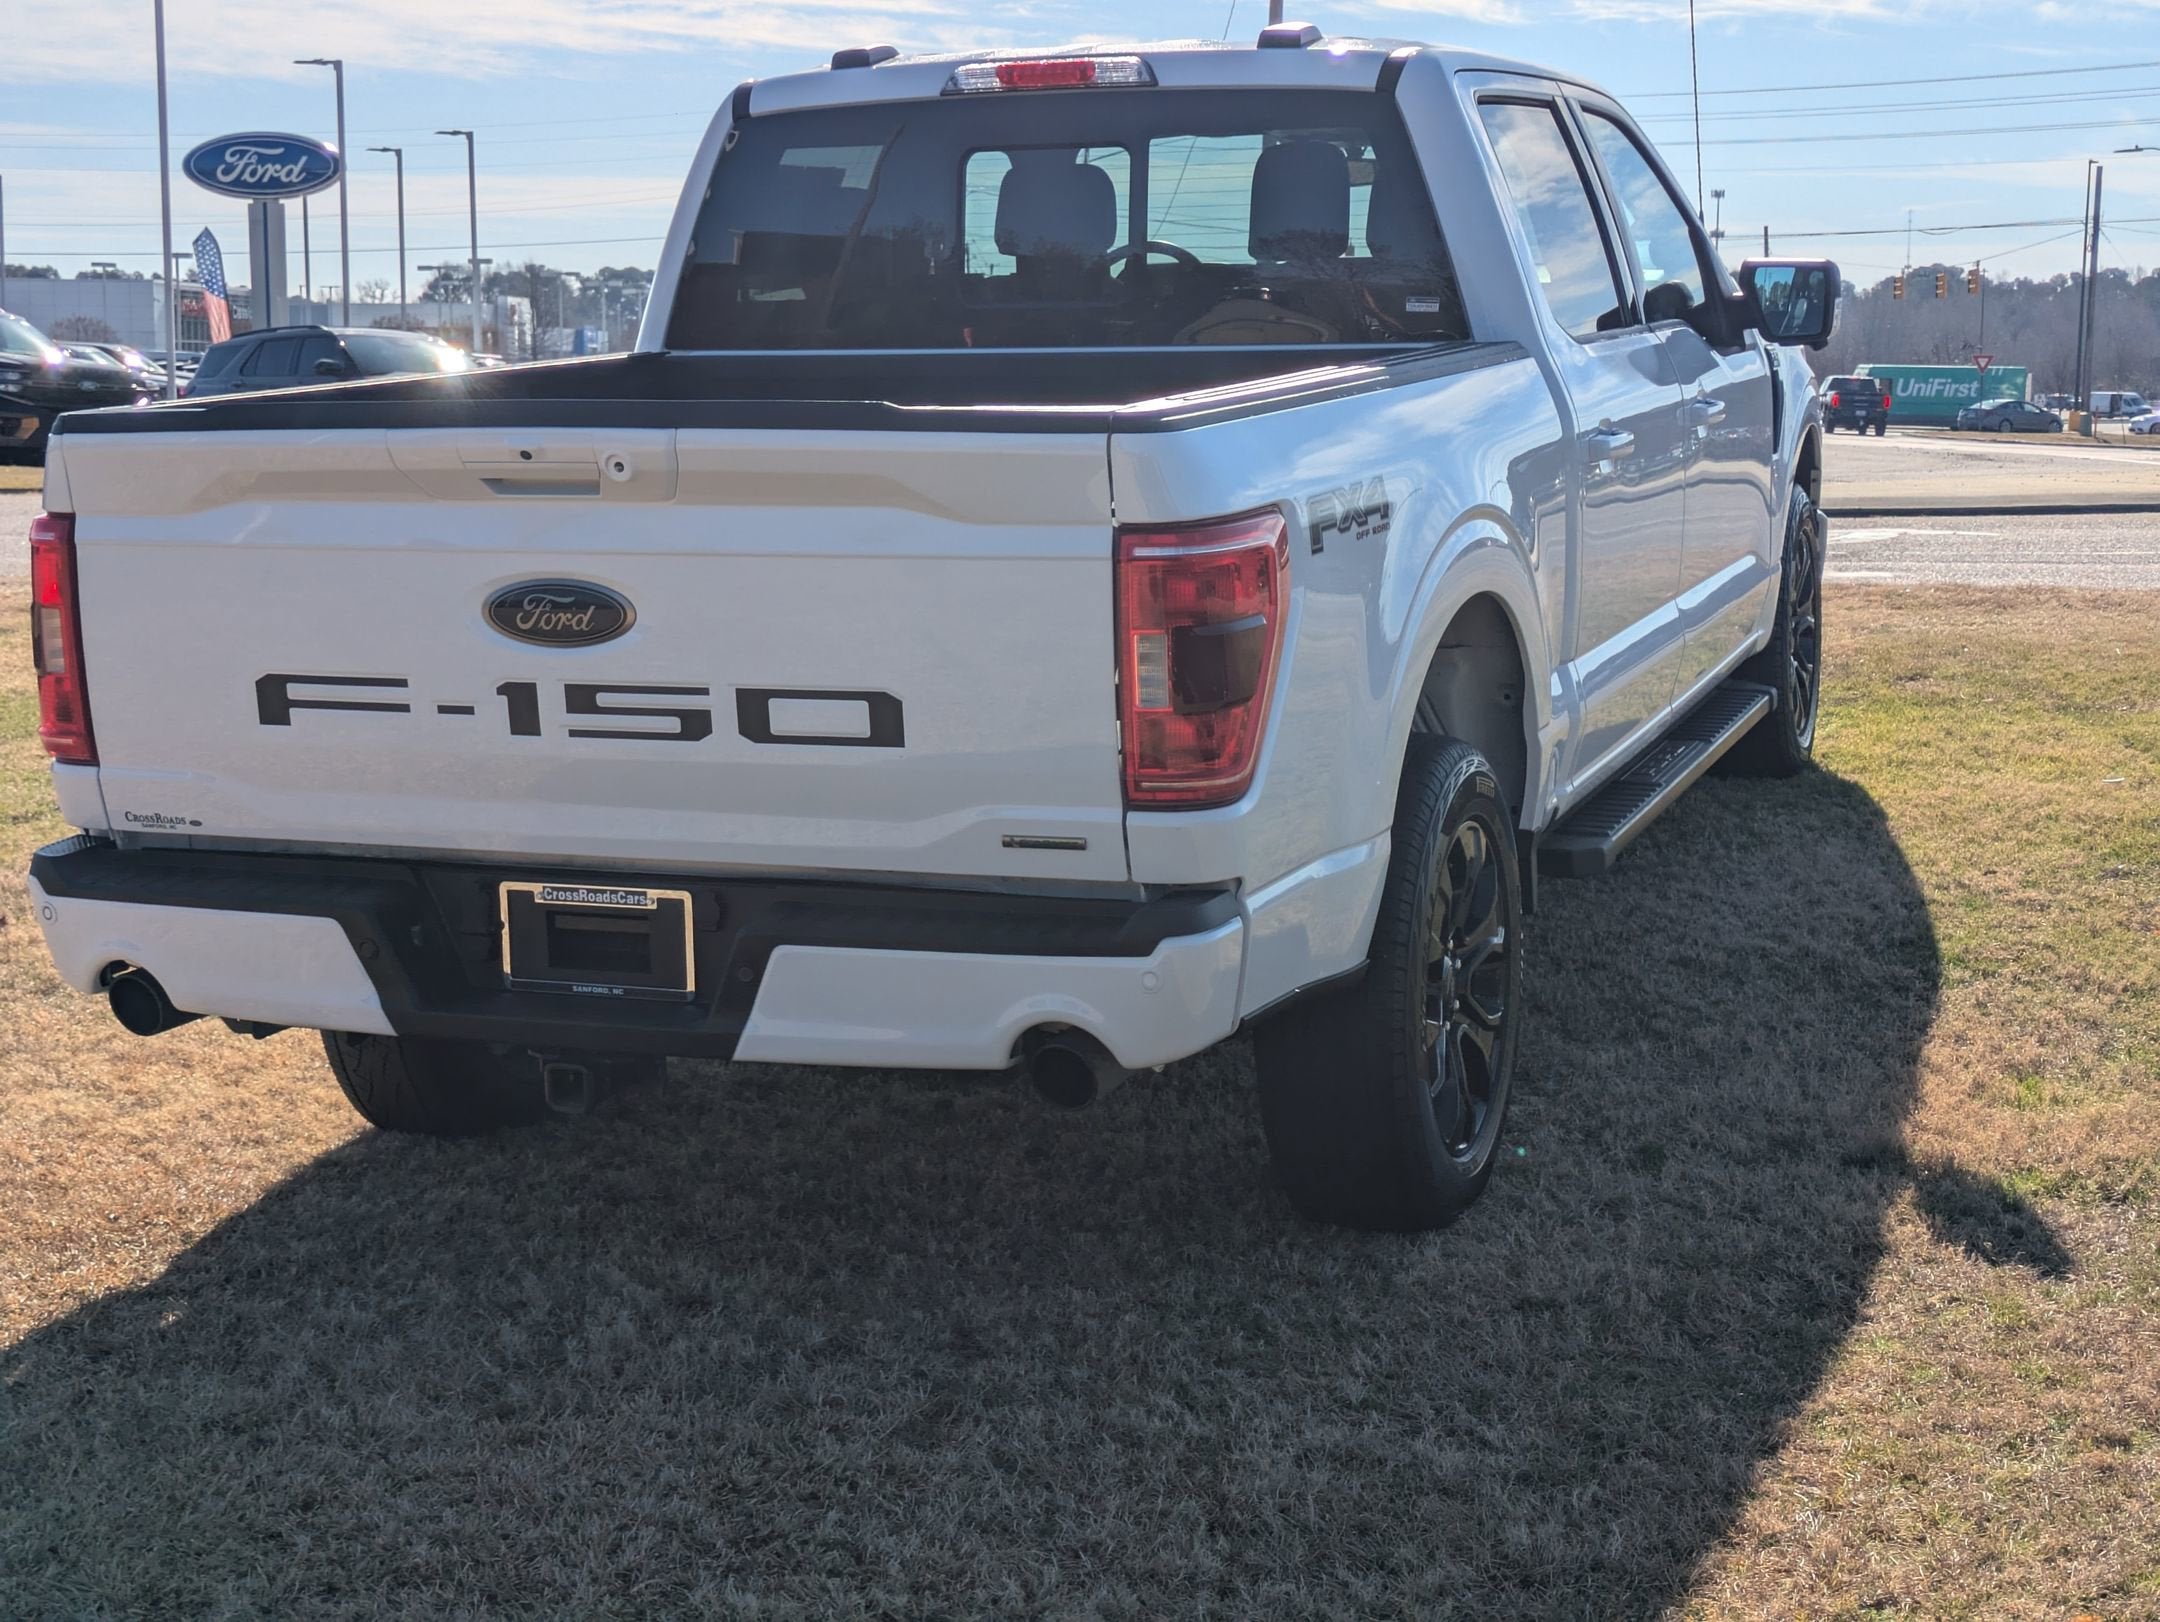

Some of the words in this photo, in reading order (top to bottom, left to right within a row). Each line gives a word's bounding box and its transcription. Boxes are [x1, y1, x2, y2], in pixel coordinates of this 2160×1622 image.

[216, 145, 308, 183] Ford
[1896, 378, 1980, 398] UniFirst
[1306, 474, 1390, 556] FX4
[1356, 529, 1370, 540] OFF
[1373, 522, 1390, 535] ROAD
[516, 592, 596, 631] Ford
[254, 672, 906, 748] F-150
[544, 888, 645, 904] CrossRoadsCars
[573, 985, 611, 995] SANFORD,
